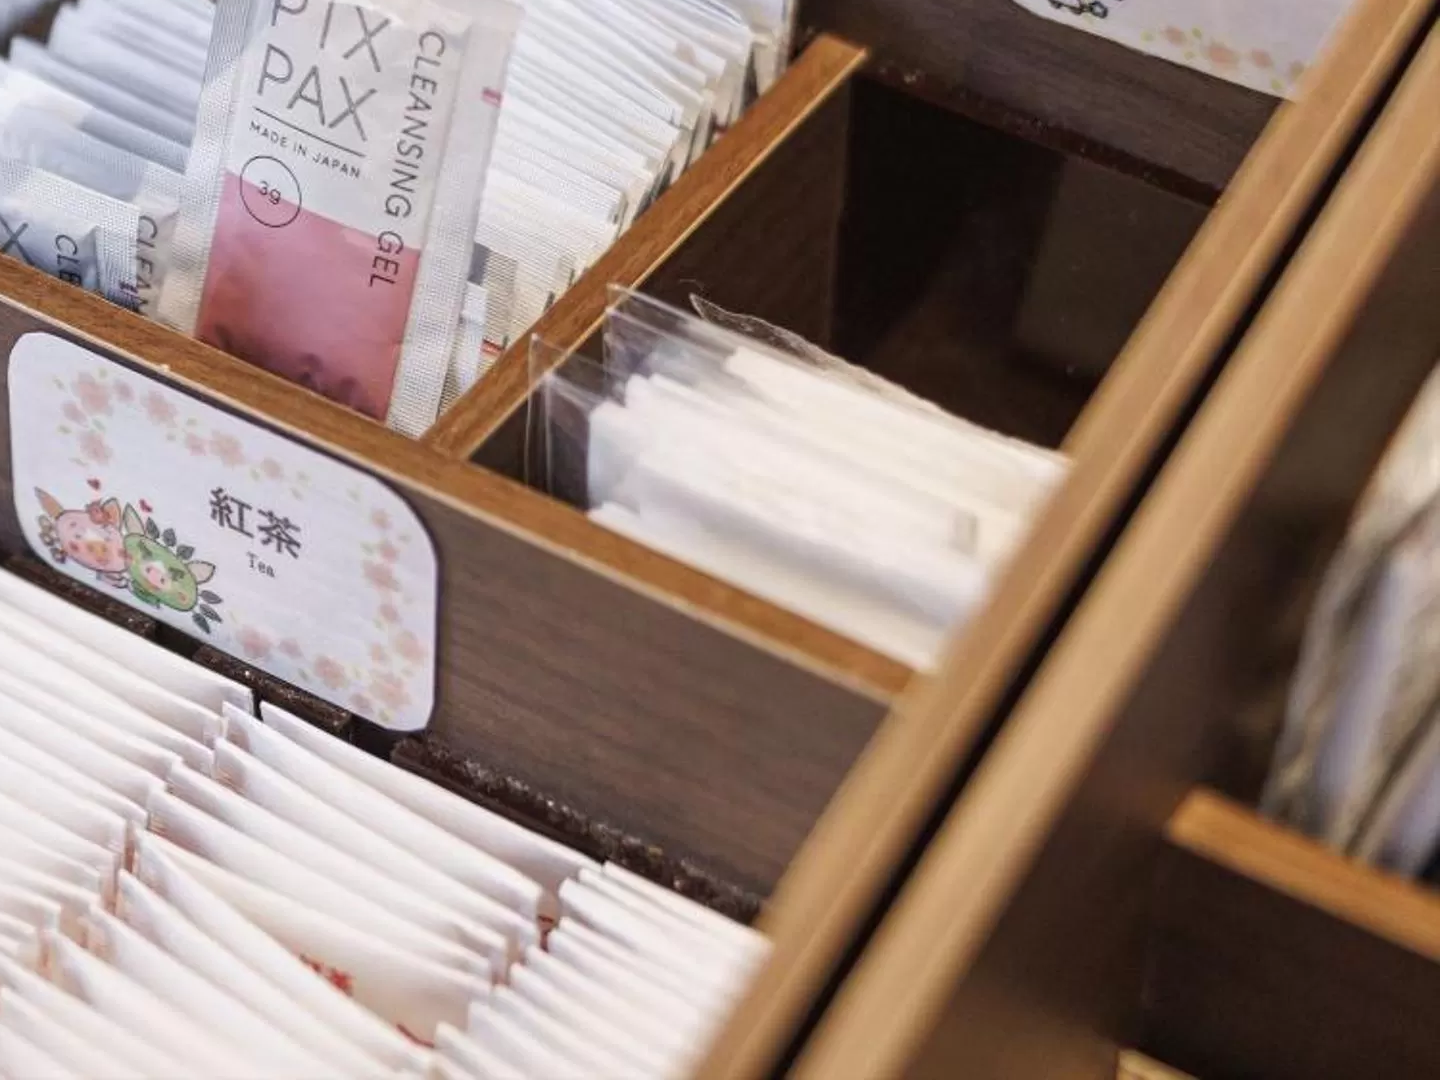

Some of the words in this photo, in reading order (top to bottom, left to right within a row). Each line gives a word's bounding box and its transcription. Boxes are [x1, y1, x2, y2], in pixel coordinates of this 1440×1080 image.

[257, 43, 378, 143] PAX
[248, 120, 289, 149] MADE
[292, 139, 308, 157] IN
[311, 148, 361, 179] JAPAN
[384, 29, 447, 219] CLEANSING
[257, 178, 282, 205] 3g
[369, 230, 405, 288] GEL
[208, 486, 303, 560] 紅茶
[245, 551, 276, 580] Tea
